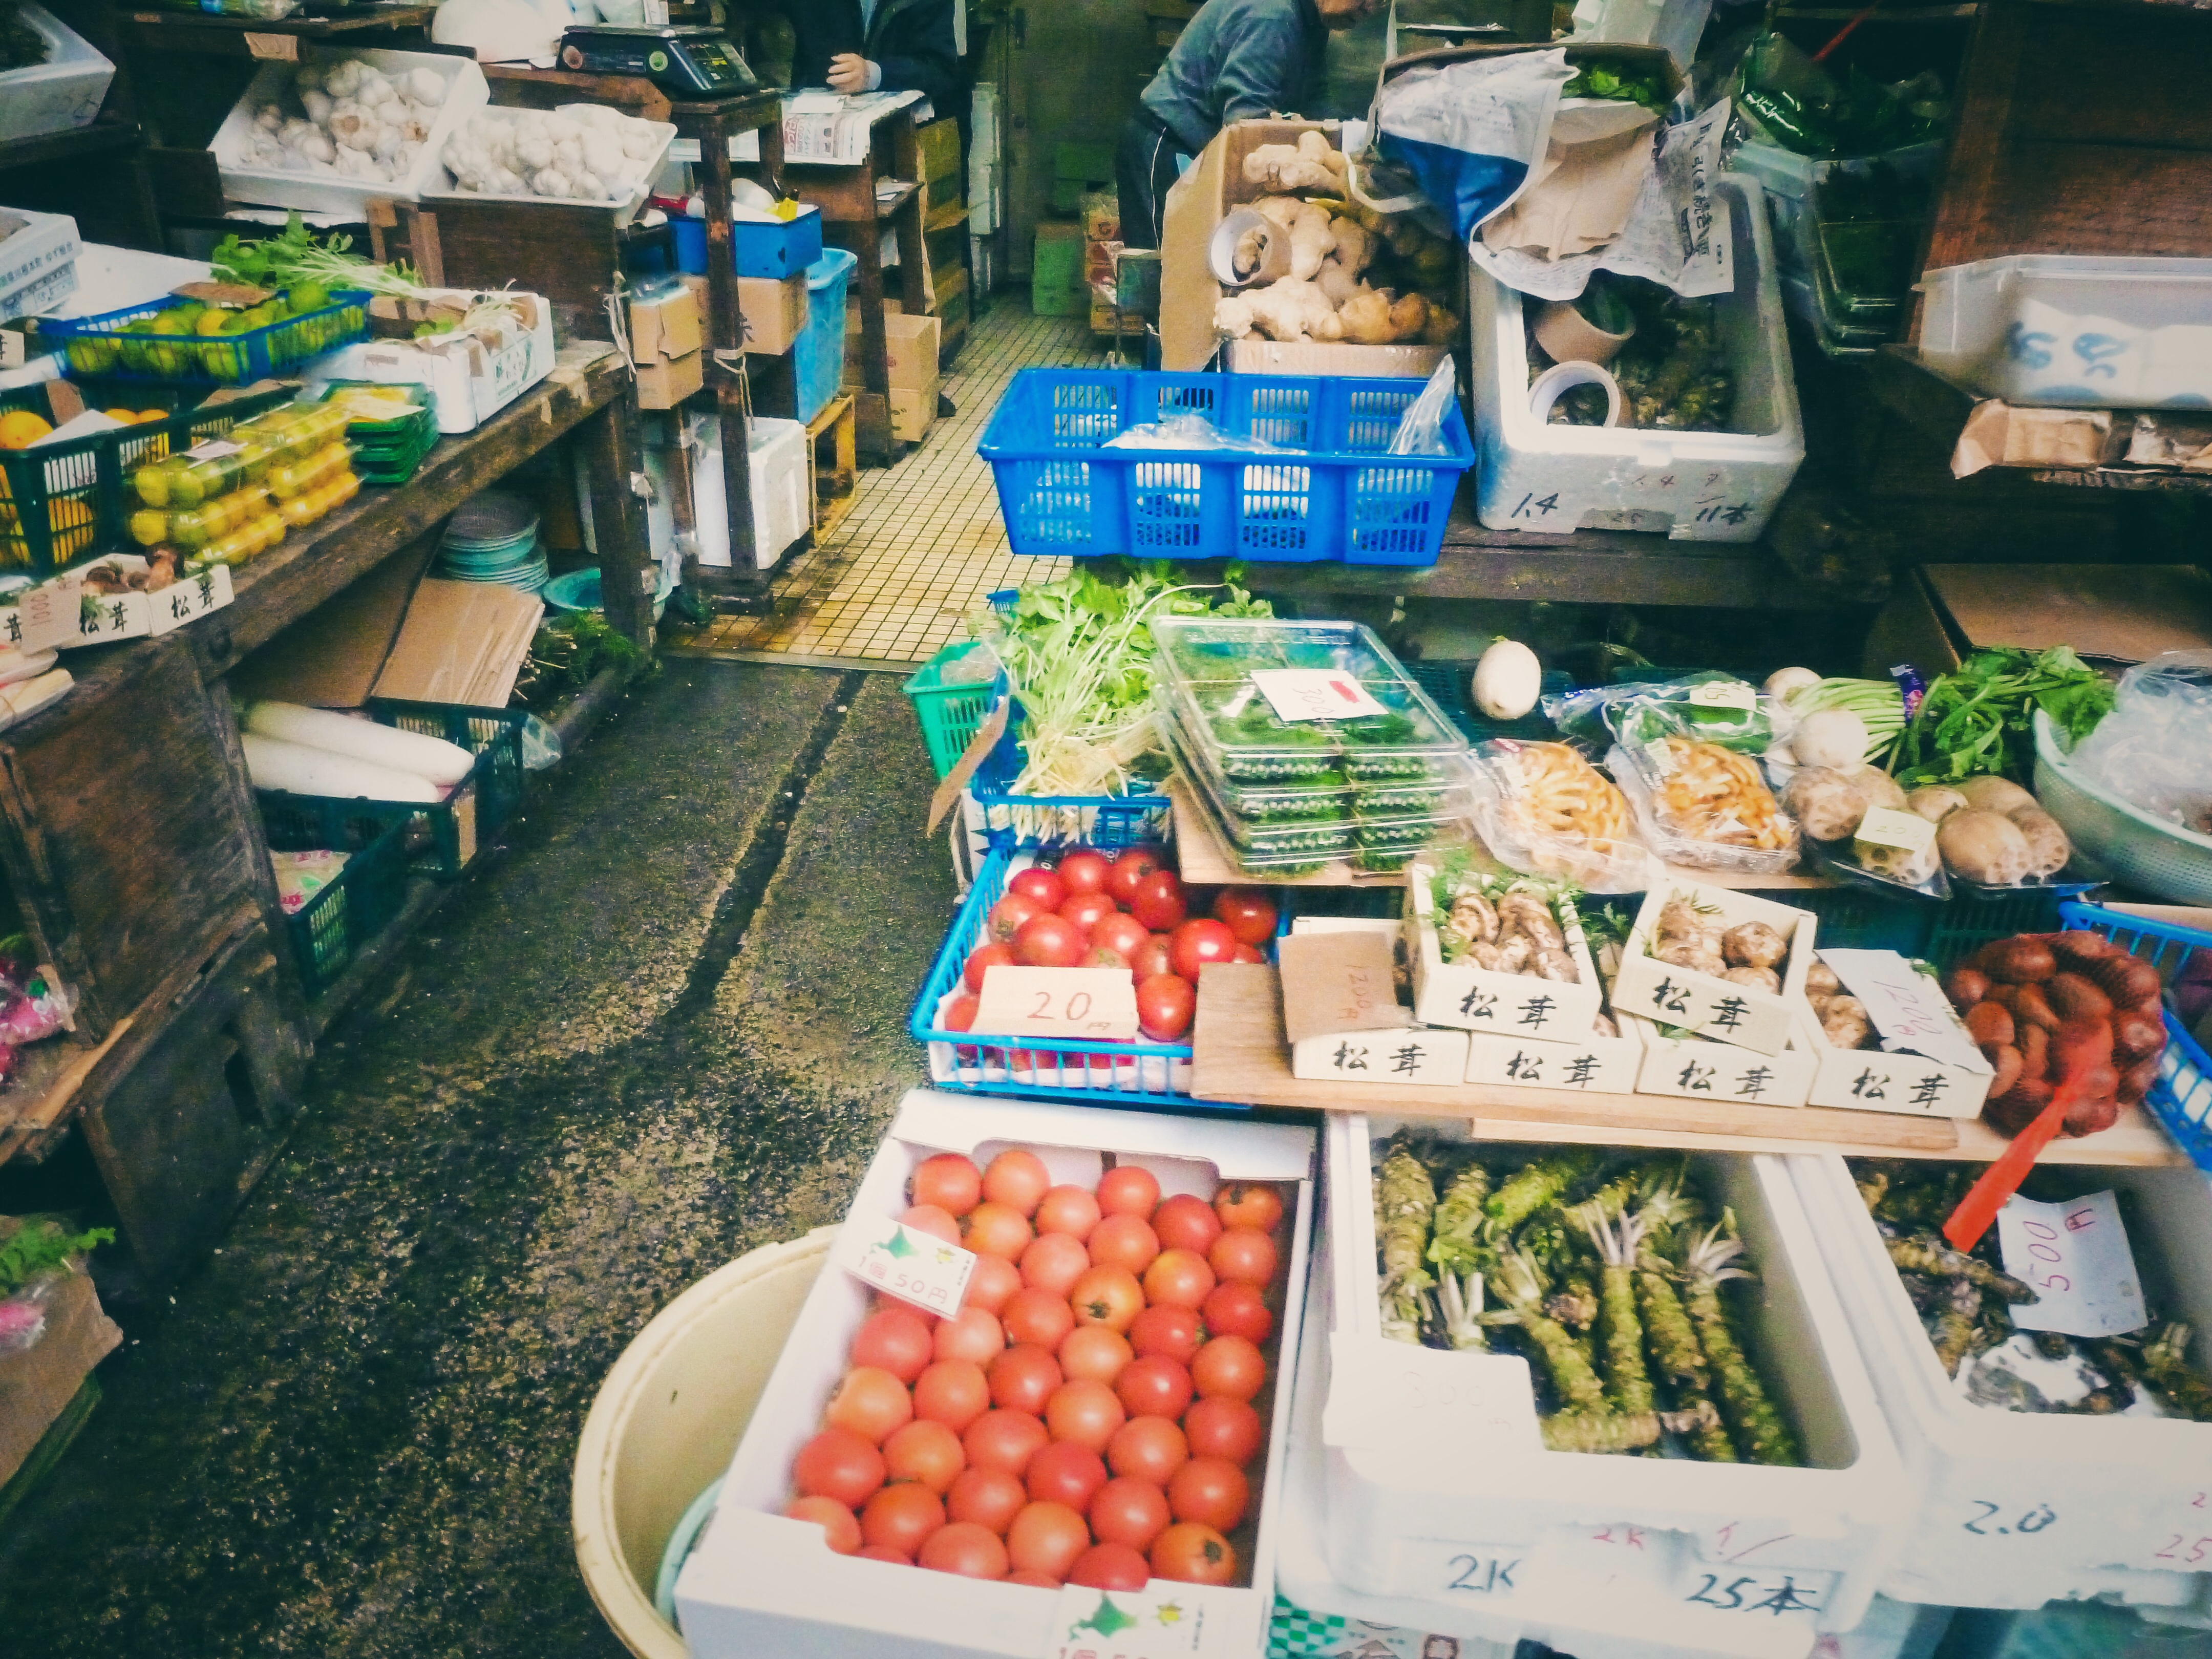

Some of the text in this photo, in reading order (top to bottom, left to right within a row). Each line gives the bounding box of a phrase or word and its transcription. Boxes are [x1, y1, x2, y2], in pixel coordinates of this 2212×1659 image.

[1512, 492, 1559, 518] 1.4
[79, 601, 128, 636] 松茸
[171, 582, 215, 621] 松茸
[1459, 985, 1558, 1030] 松茸
[1652, 975, 1751, 1034] 松茸
[1333, 1040, 1428, 1077] 松茸
[1506, 1050, 1603, 1089] 松茸
[1677, 1058, 1775, 1100] 松茸
[1851, 1066, 1950, 1110] 松茸
[1447, 1554, 1523, 1592] 2K
[1685, 1573, 1821, 1617] 25本
